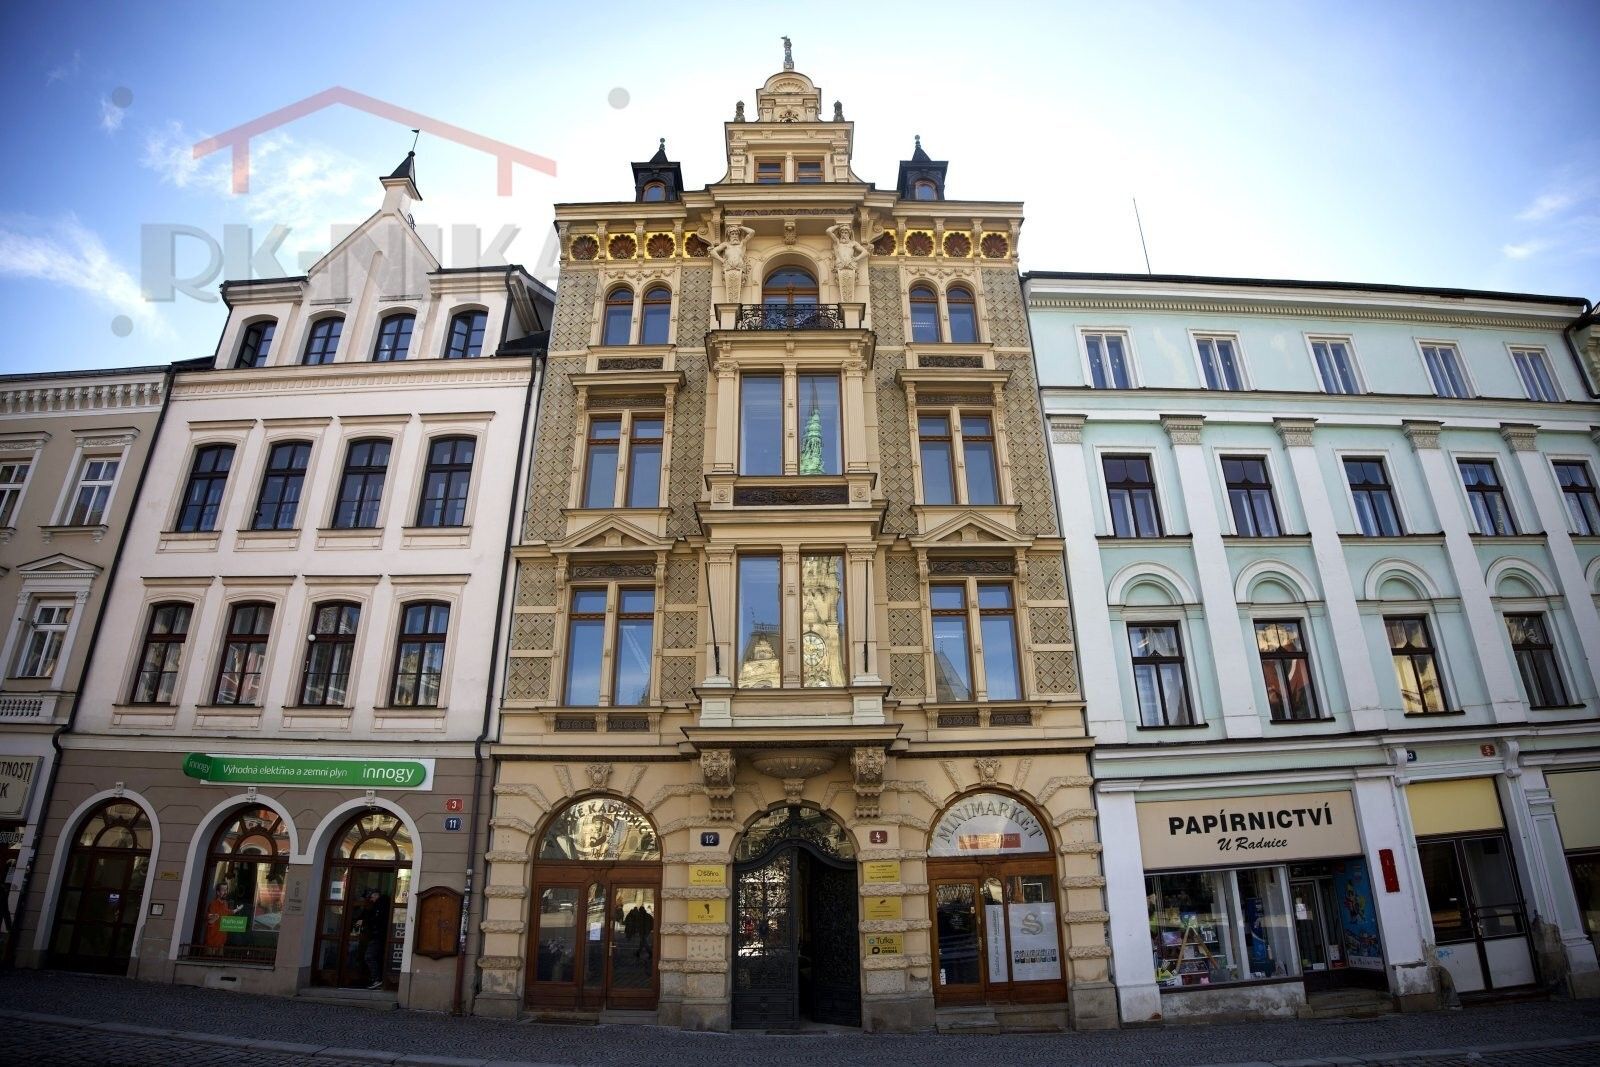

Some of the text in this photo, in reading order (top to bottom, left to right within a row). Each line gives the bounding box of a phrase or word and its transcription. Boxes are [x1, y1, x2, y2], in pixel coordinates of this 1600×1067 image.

[0, 761, 34, 784] TNOSTI
[223, 764, 258, 775] Výhodná
[259, 765, 295, 775] elektřina
[303, 768, 329, 777] zemní
[329, 768, 348, 779] plyn
[362, 764, 415, 783] innogy
[451, 800, 457, 809] 3
[449, 819, 457, 829] 11
[937, 800, 1043, 843] MINIMARKET
[1168, 802, 1333, 836] PAPÍRNICTVÍ
[705, 834, 714, 844] 12
[1217, 836, 1288, 851] U Radnice
